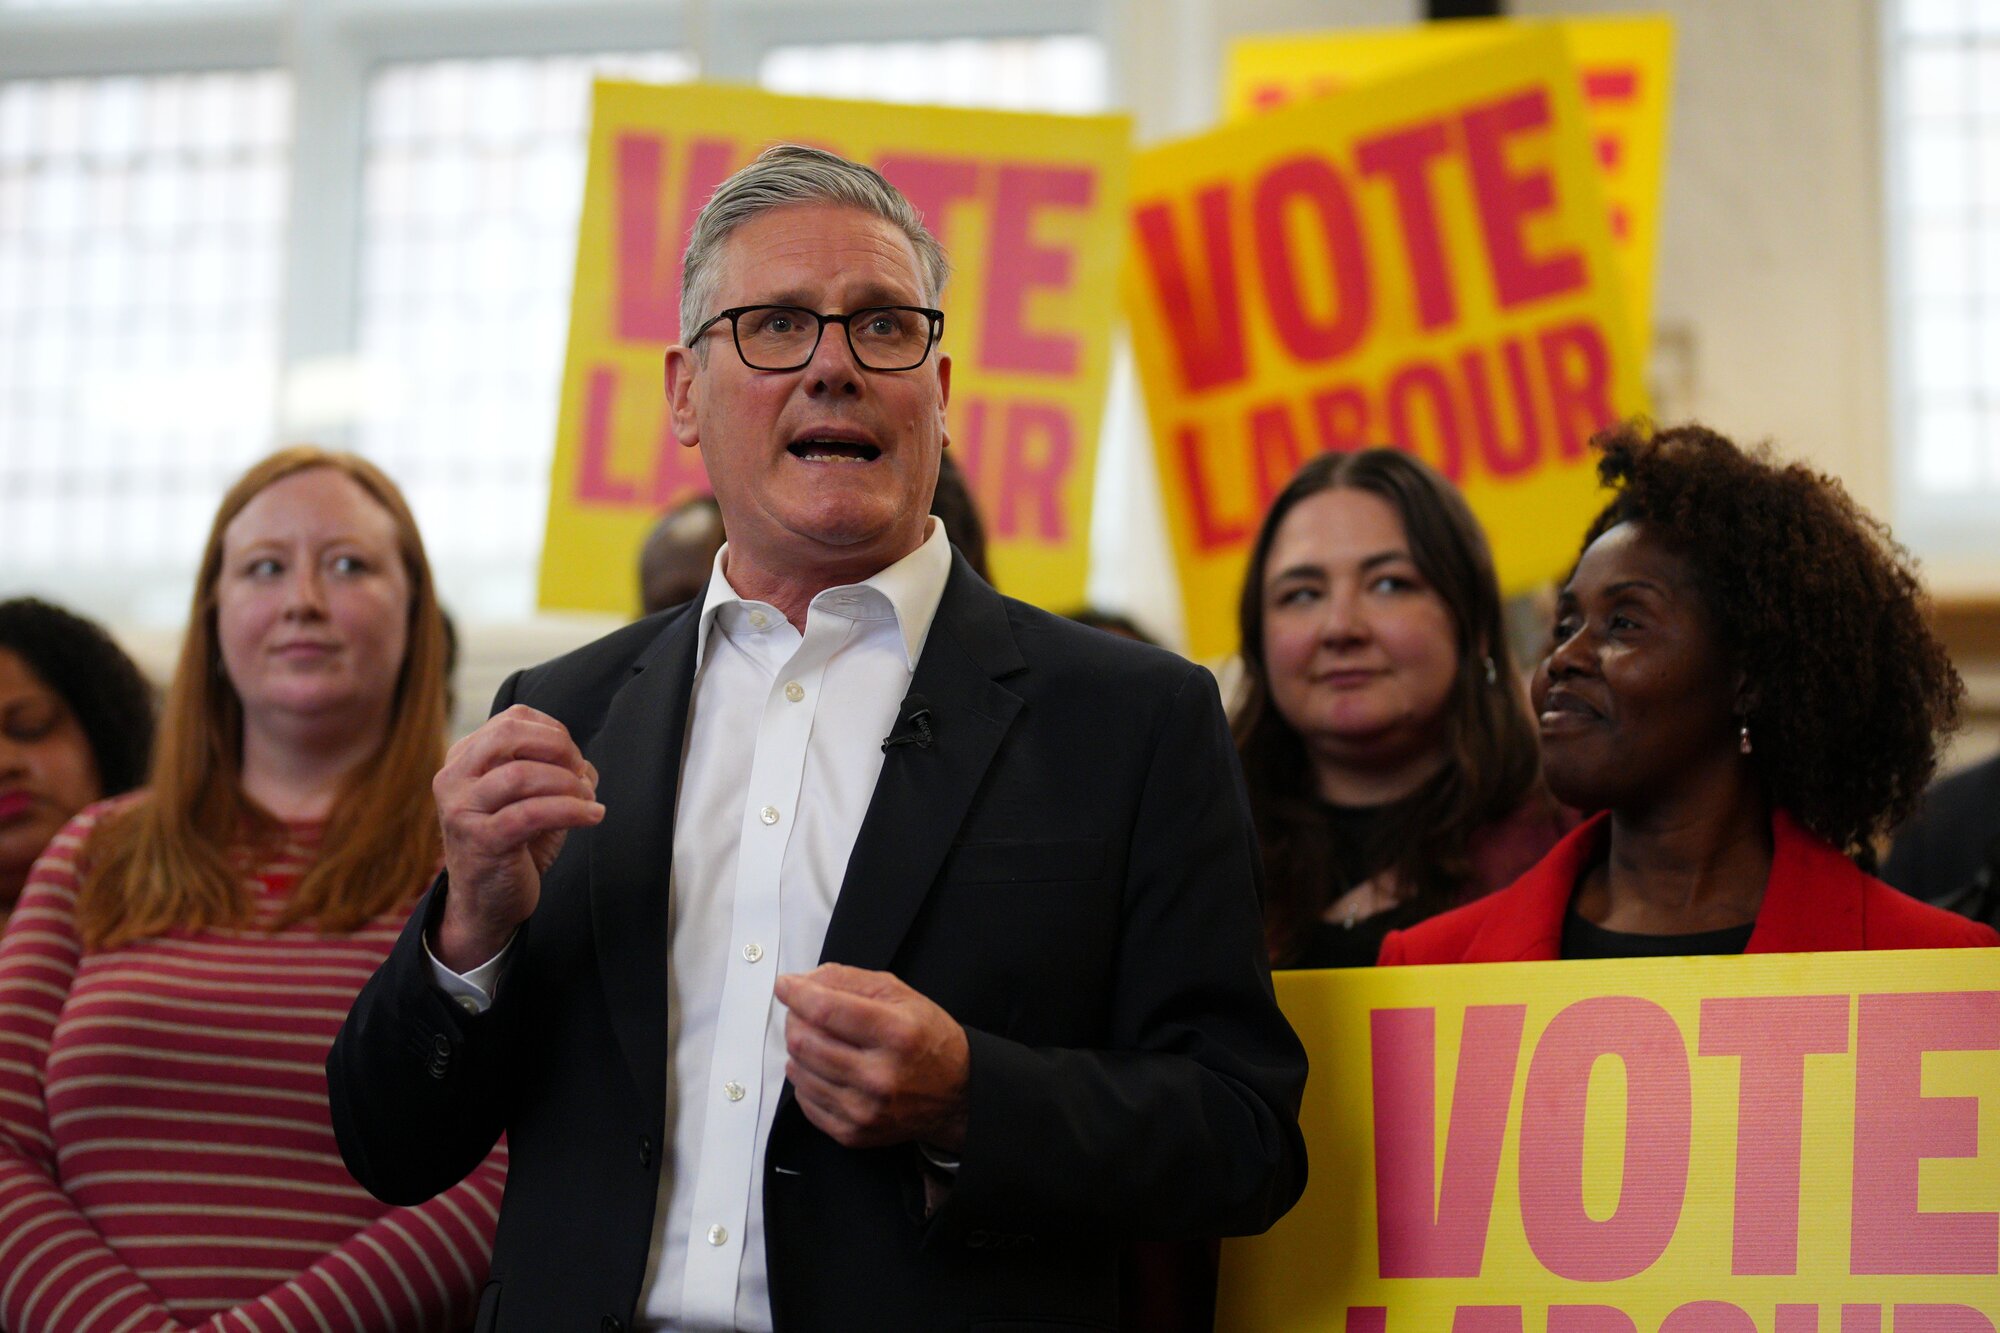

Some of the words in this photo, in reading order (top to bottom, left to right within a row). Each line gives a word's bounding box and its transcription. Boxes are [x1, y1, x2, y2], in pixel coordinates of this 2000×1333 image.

[610, 130, 1096, 380] VTE
[1132, 84, 1590, 393] VOTE
[1370, 990, 2000, 1282] VOTE
